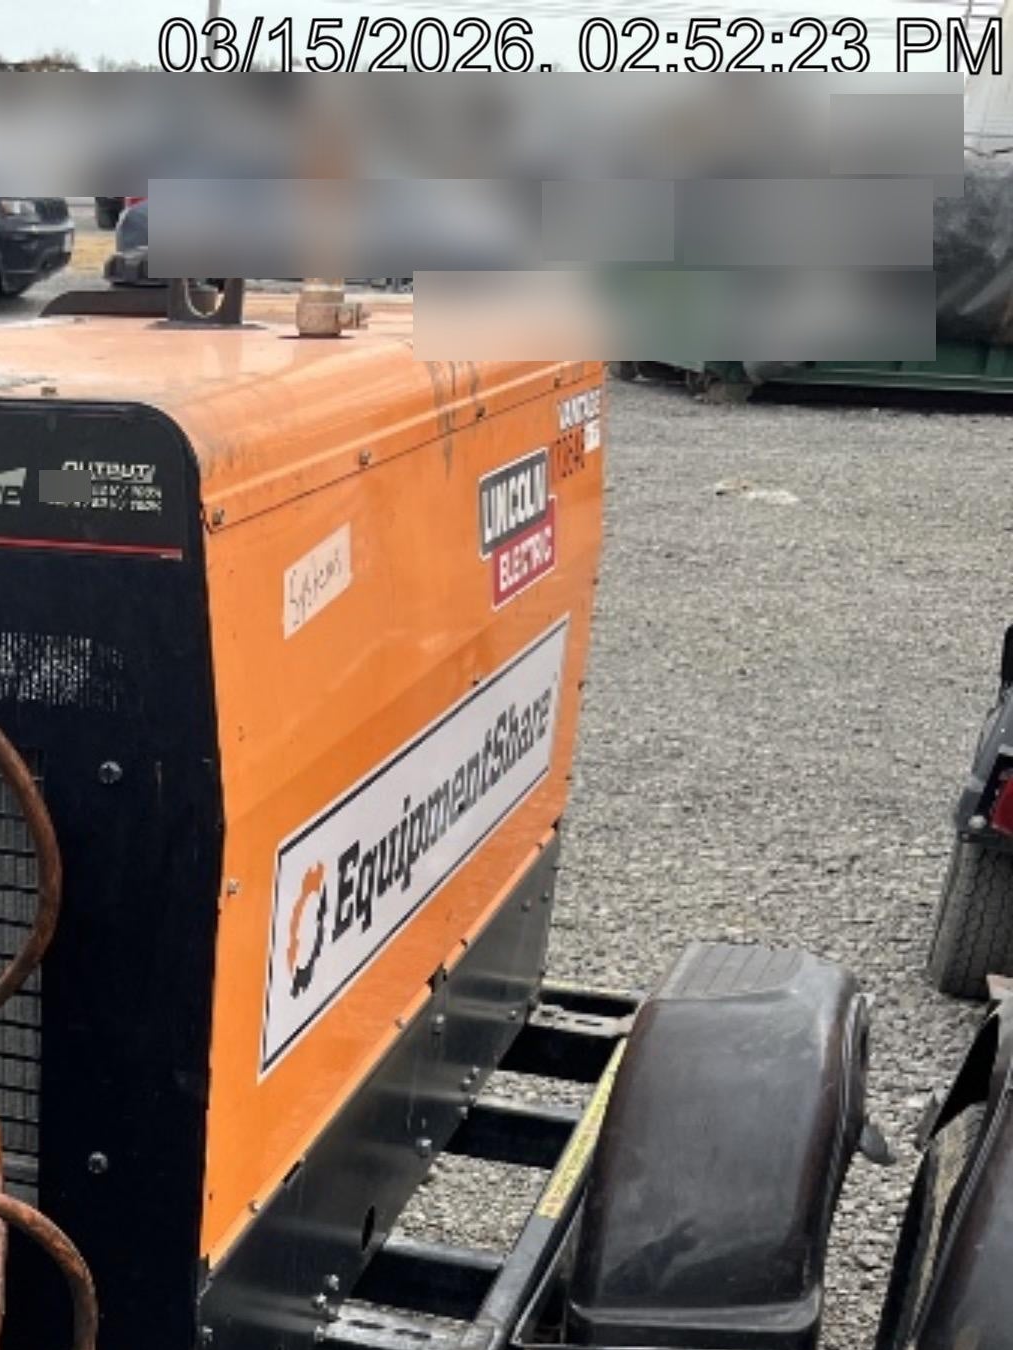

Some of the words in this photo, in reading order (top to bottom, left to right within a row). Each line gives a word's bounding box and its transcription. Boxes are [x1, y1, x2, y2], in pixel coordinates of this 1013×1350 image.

[482, 461, 547, 545] LINCOLN
[499, 524, 552, 592] ELECTRIC
[332, 687, 551, 943] EquipmentShare
